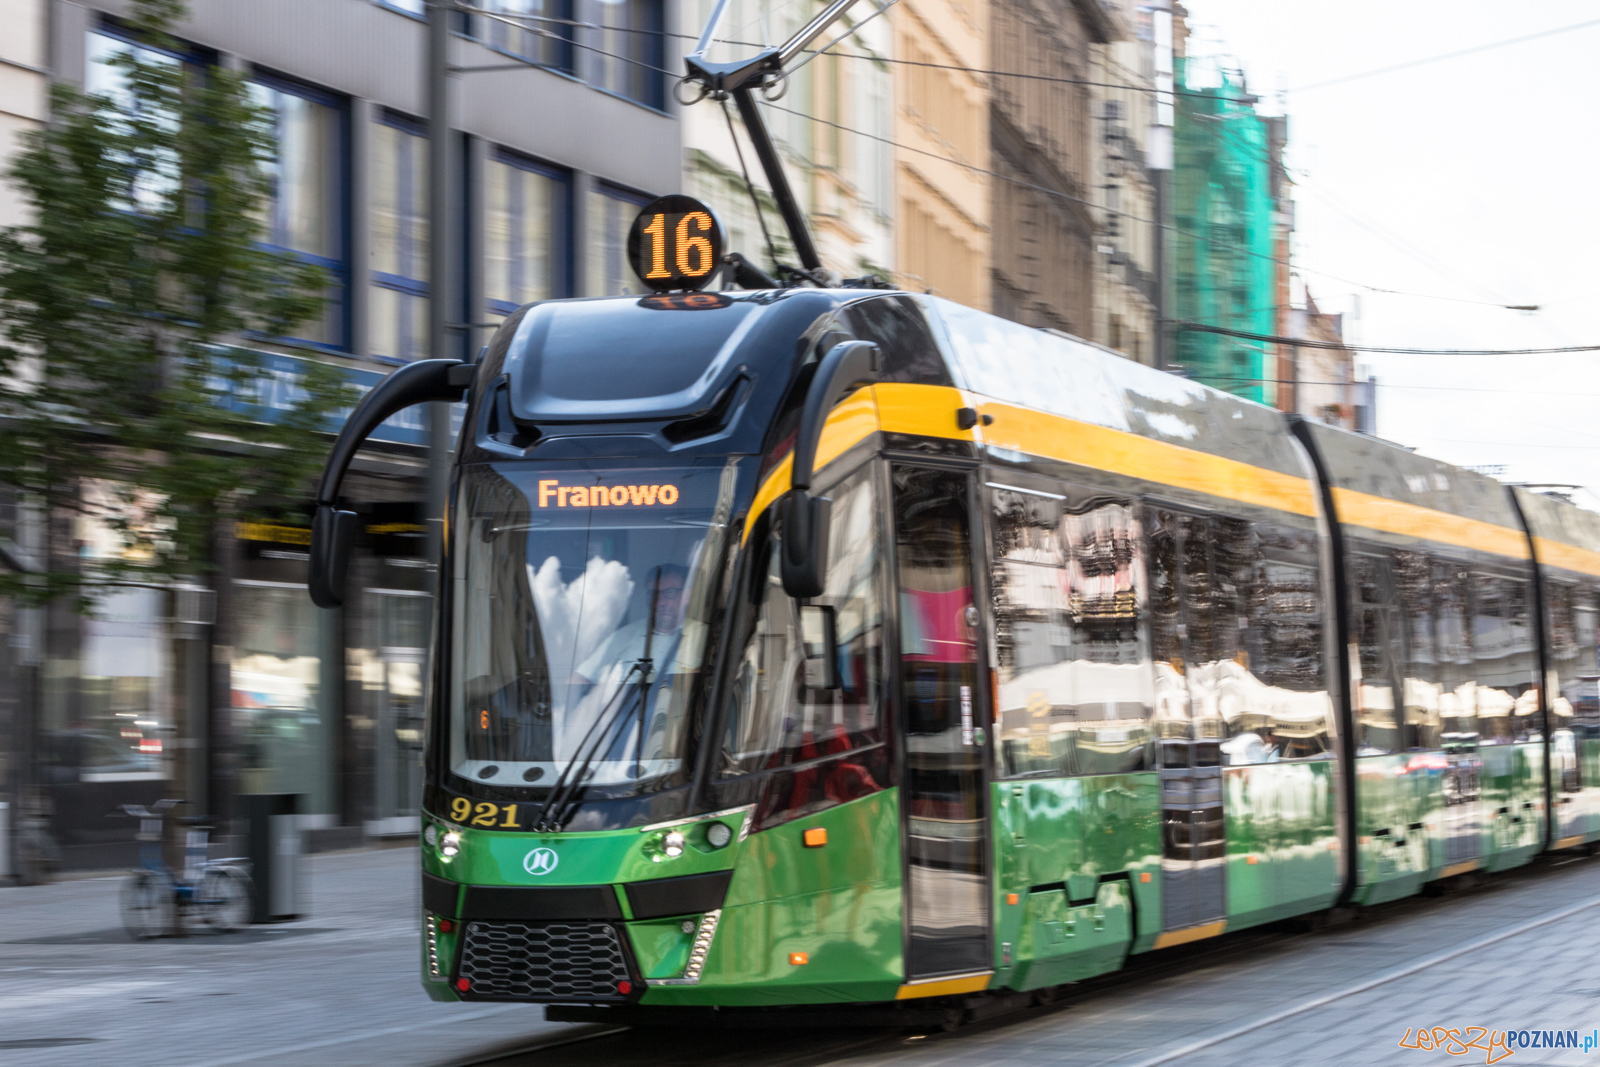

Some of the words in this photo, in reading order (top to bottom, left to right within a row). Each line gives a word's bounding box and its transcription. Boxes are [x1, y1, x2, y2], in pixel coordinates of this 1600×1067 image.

[643, 211, 713, 279] 16
[538, 479, 679, 508] Franowo
[449, 797, 521, 828] 921
